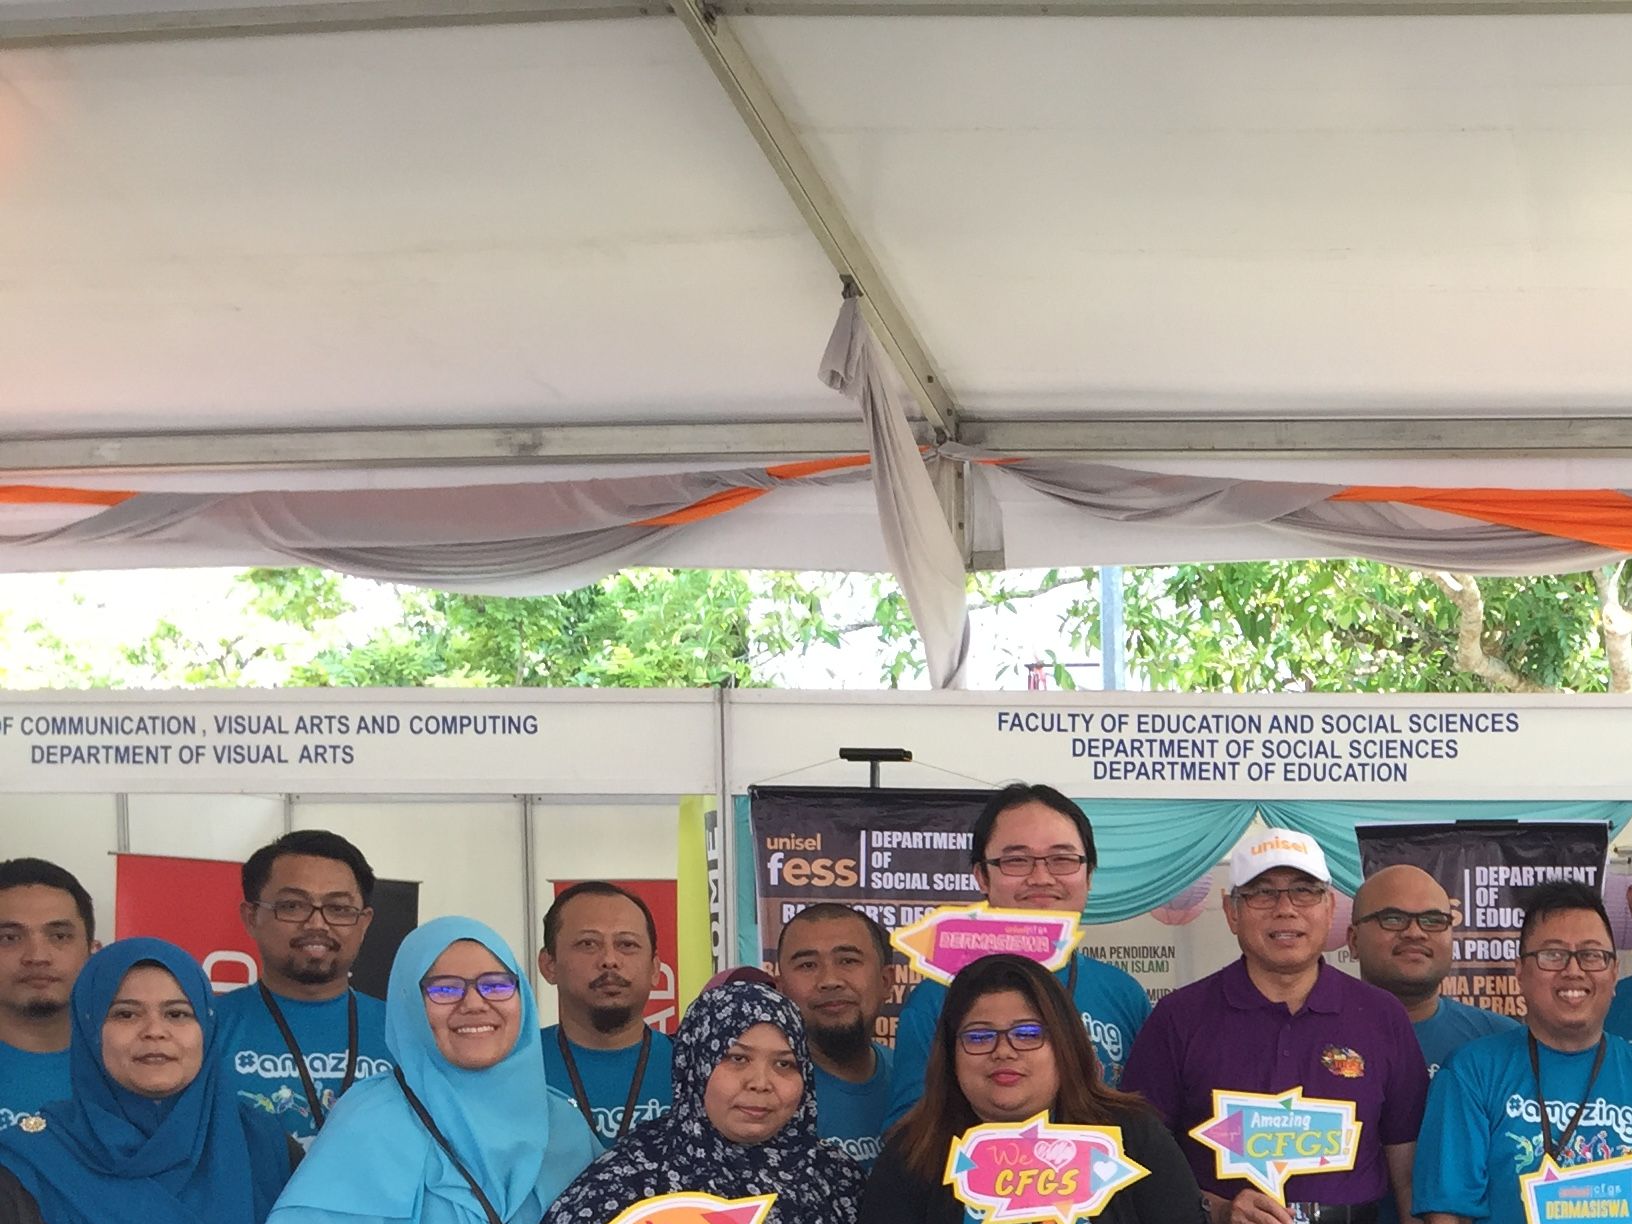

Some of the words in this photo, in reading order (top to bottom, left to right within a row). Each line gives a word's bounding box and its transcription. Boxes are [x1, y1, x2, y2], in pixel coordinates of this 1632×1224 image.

[214, 714, 289, 735] VISUAL
[294, 714, 351, 735] ARTS
[356, 715, 400, 735] AND
[409, 715, 539, 735] COMPUTING
[997, 712, 1095, 732] FACULTY
[1100, 713, 1130, 734] OF
[1137, 714, 1262, 734] EDUCATION
[1268, 714, 1314, 734] AND
[1321, 714, 1402, 734] SOCIAL
[1408, 712, 1519, 733] SCIENCES
[31, 744, 172, 764] DEPARTMENT
[178, 744, 207, 764] OF
[213, 744, 288, 764] VISUAL
[298, 744, 355, 764] ARTS
[1072, 738, 1219, 758] DEPARTMENT
[1225, 739, 1254, 759] OF
[1261, 739, 1342, 759] SOCIAL
[1349, 739, 1459, 759] SCIENCES
[1093, 761, 1241, 781] DEPARTMENT
[1247, 761, 1276, 782] OF
[1283, 762, 1408, 782] EDUCATION
[766, 833, 822, 850] unisel
[871, 830, 974, 850] DEPARTMENT
[1250, 835, 1309, 856] unisel
[767, 852, 859, 888] fess
[871, 851, 892, 869] OF
[871, 872, 931, 891] SOCIAL
[933, 873, 981, 891] SCIEN
[1475, 866, 1598, 887] DEPARTMENT
[1475, 887, 1499, 908] OF
[1109, 945, 1176, 959] PENDIDIKAN
[1131, 959, 1170, 973] ISLAM)
[1250, 1111, 1312, 1131] Amazing
[987, 1142, 1035, 1166] We
[1246, 1128, 1354, 1159] CFGS!
[994, 1167, 1080, 1197] CFGS
[1545, 1198, 1630, 1221] DERMASISWA
